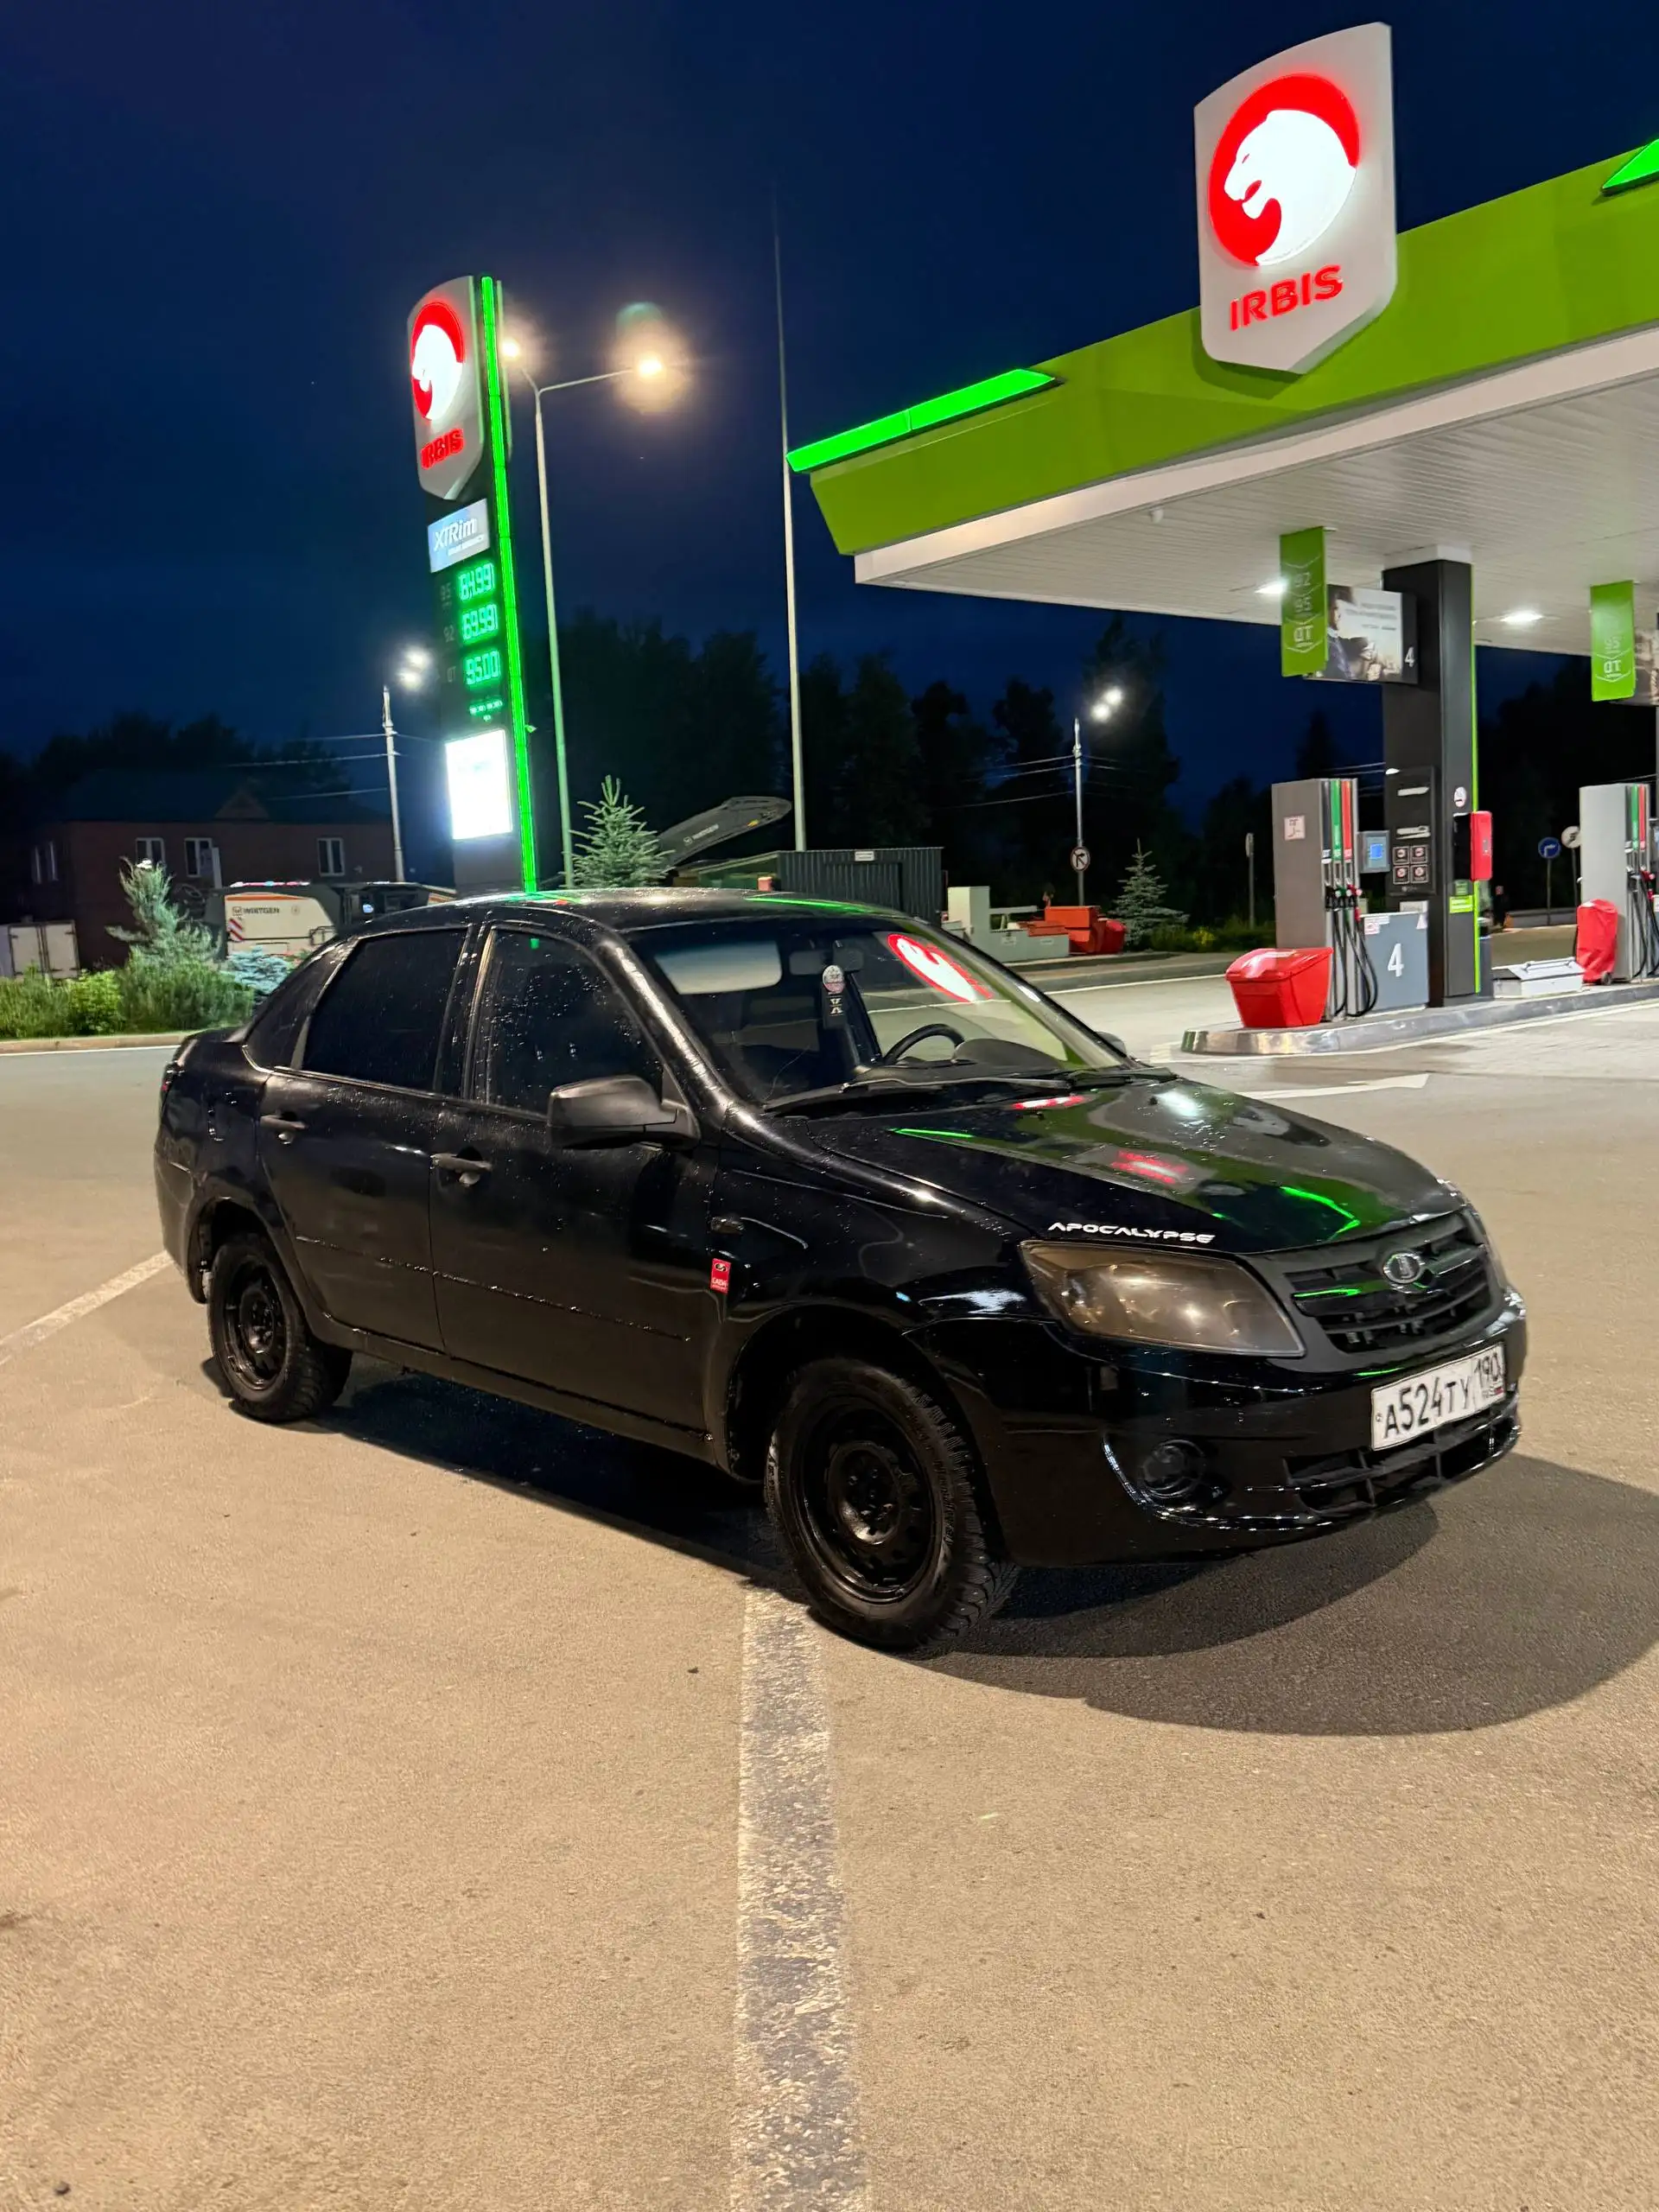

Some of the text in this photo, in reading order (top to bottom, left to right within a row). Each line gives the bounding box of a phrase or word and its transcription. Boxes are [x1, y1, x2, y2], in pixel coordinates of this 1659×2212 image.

[1230, 264, 1343, 331] IRBIS
[421, 429, 464, 469] IRBIS
[1404, 646, 1415, 667] 4
[1388, 943, 1404, 976] 4
[1048, 1222, 1216, 1243] APOCALYPSE
